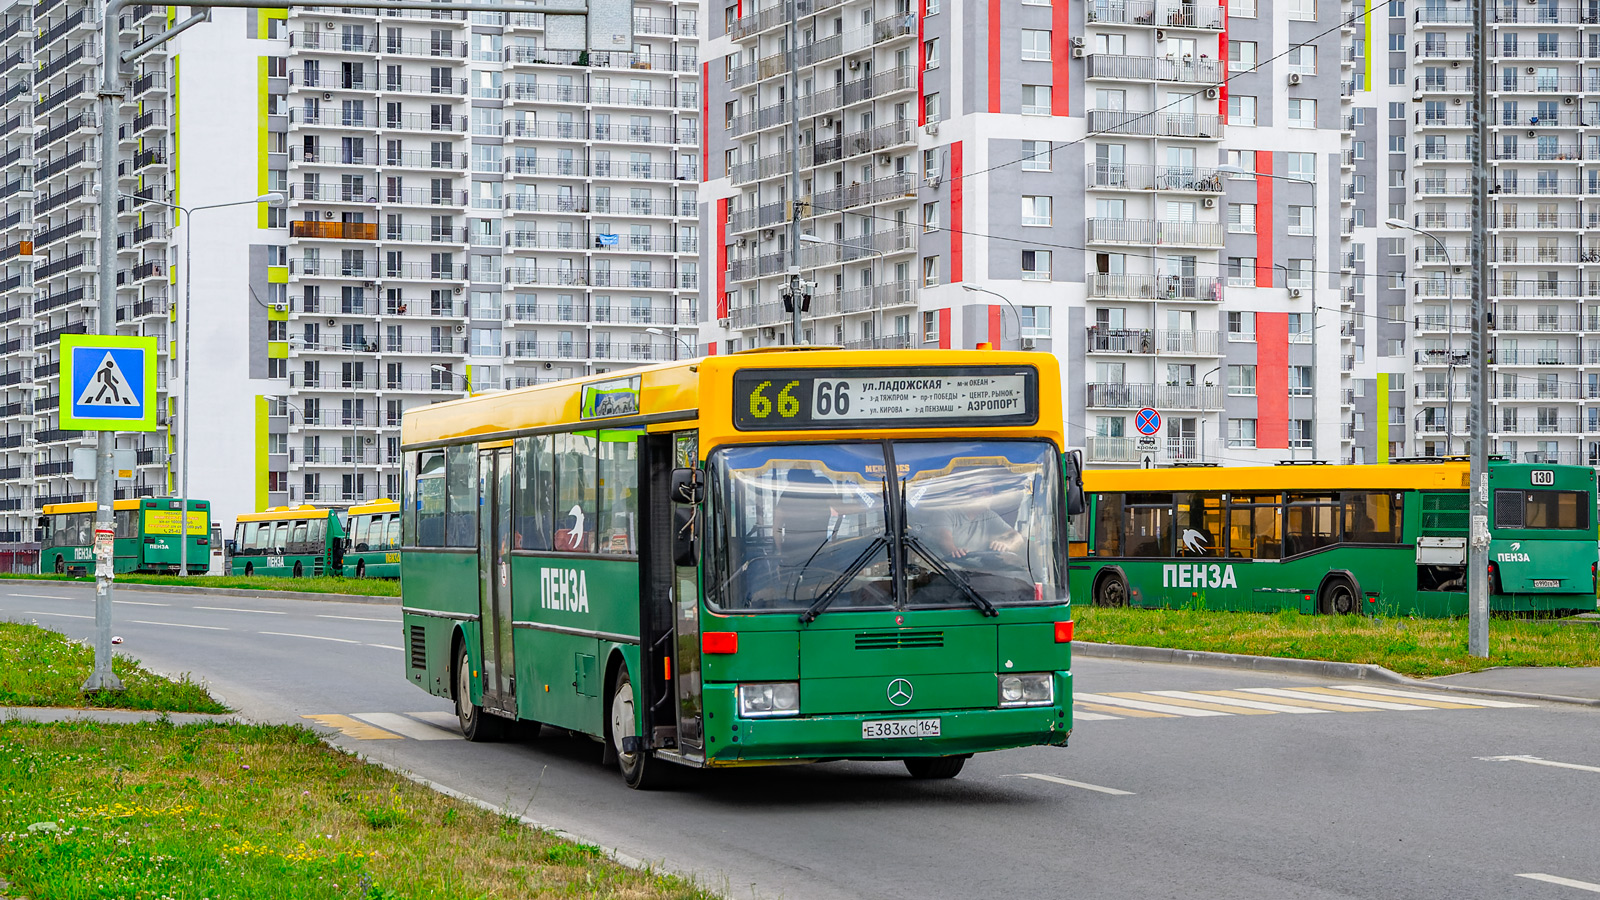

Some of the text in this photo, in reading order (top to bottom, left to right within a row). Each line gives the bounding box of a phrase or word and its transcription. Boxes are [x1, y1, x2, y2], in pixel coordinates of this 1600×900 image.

[749, 380, 800, 418] 66
[816, 381, 850, 416] 66
[880, 394, 909, 402] ТЯЖПРОМ
[920, 394, 933, 402] пр-т
[933, 393, 958, 401] ПОБЕДЫ
[969, 391, 990, 399] ЦЕНТР.
[991, 389, 1014, 398] РЫНОК
[924, 405, 954, 413] ПЕНЗМАШ
[967, 398, 1018, 411] АЭРОПОРТ
[1534, 471, 1551, 483] 130
[74, 547, 93, 560] ПЕНЗА
[1497, 553, 1530, 562] ПЕНЗА
[267, 556, 285, 568] ПЕНЗА
[1163, 563, 1237, 589] ПЕНЗА
[540, 567, 589, 614] ПЕНЗА
[867, 720, 938, 737] Е383КС 164
